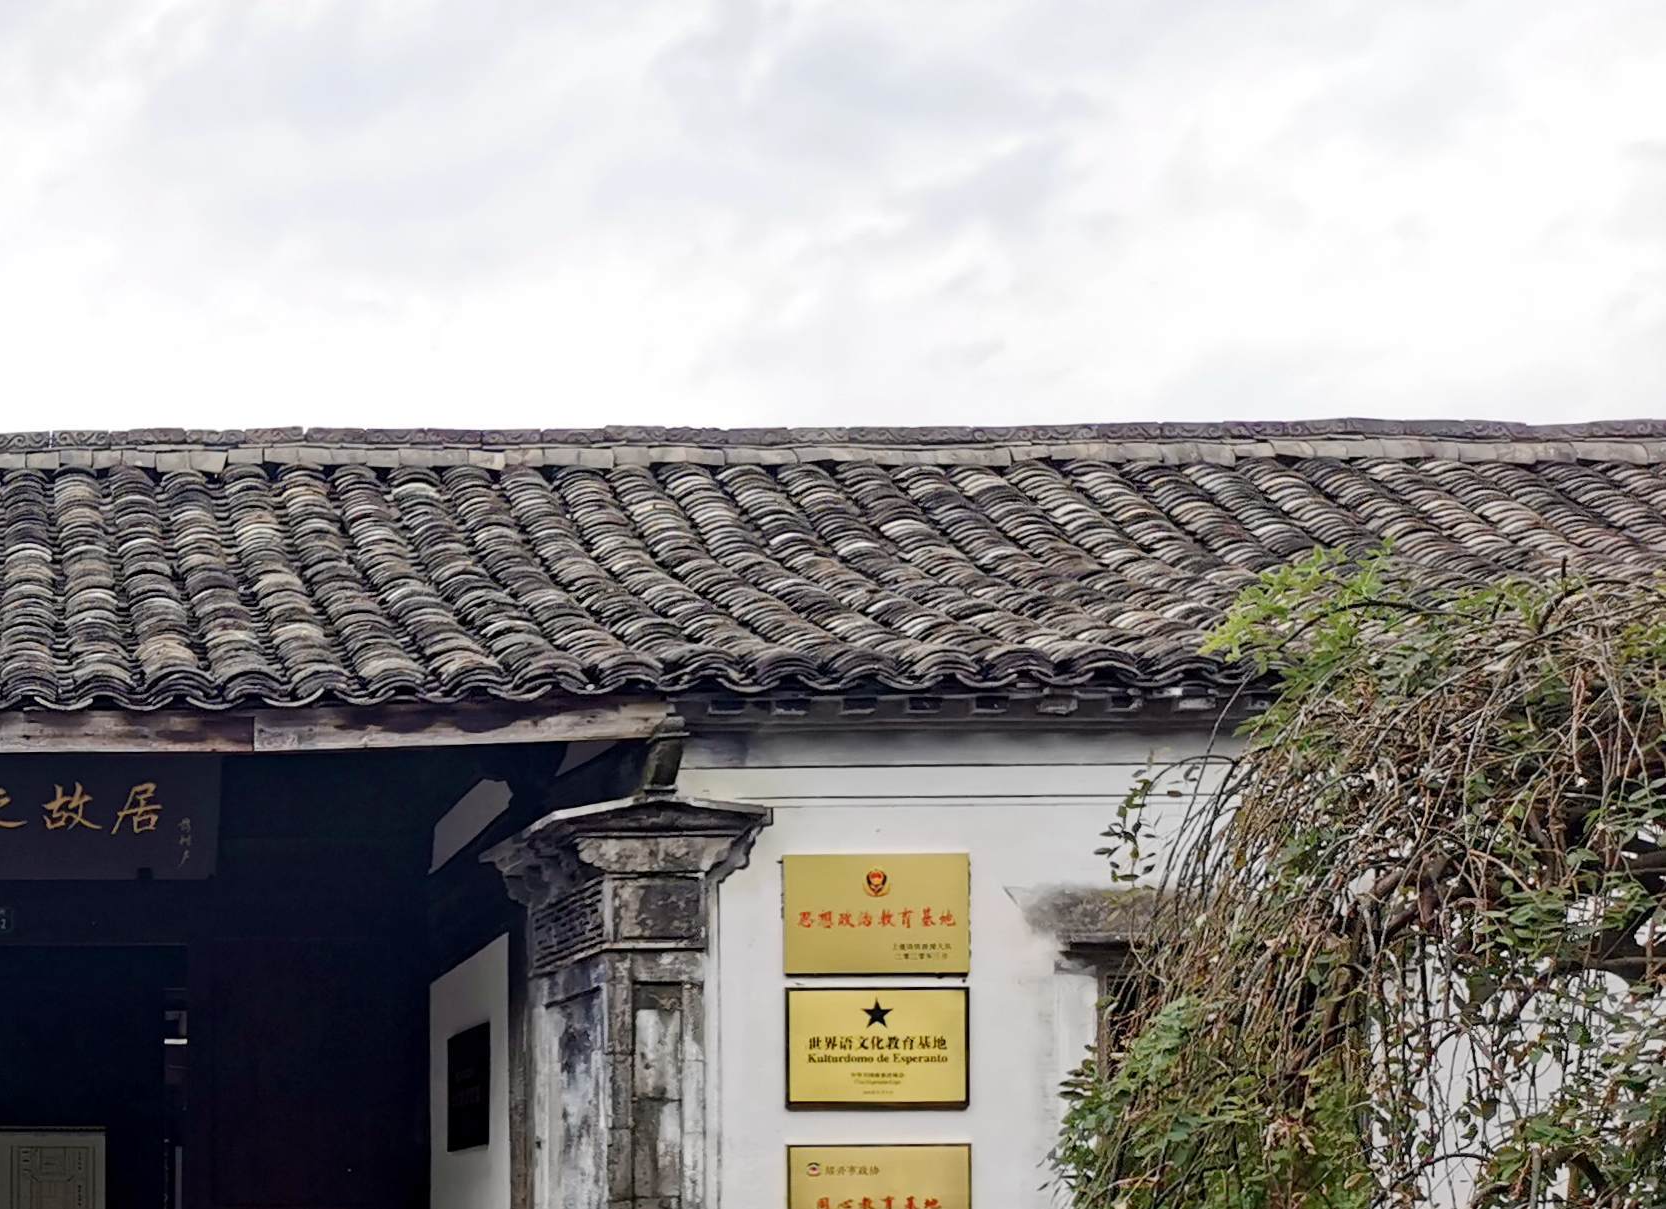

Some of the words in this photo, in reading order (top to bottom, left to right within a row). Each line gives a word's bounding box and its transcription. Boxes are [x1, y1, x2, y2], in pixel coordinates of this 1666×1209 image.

[797, 907, 956, 929] 思想政治教育基地
[808, 1035, 948, 1051] 世界语文化教育基地
[807, 1053, 874, 1064] Kulturdomo
[877, 1053, 889, 1063] de
[893, 1053, 949, 1066] Esperanto
